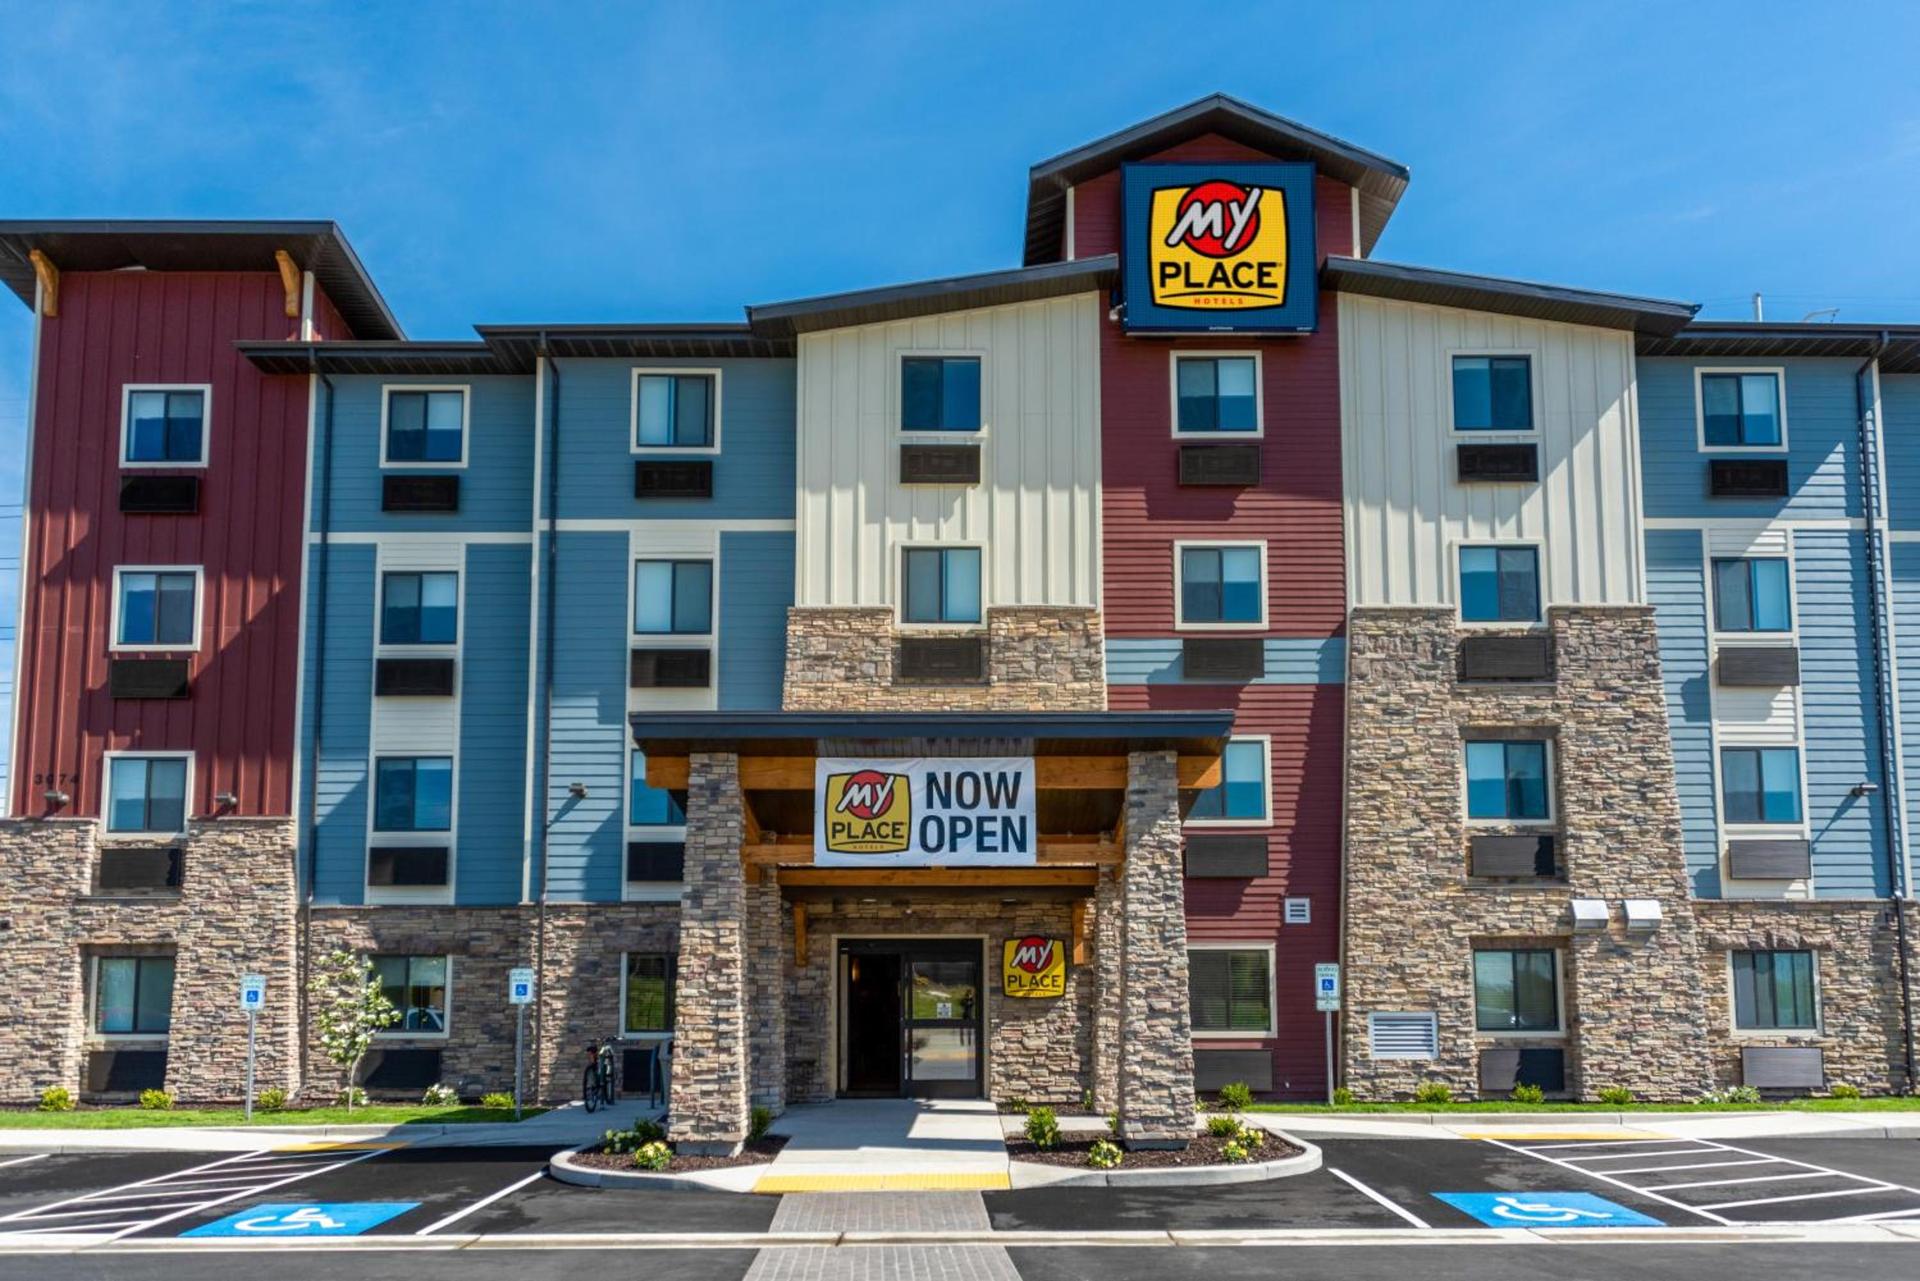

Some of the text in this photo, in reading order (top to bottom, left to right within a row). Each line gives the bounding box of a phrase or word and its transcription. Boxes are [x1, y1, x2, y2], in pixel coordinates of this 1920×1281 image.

[1159, 261, 1278, 288] PLACE
[926, 771, 1022, 810] NOW
[832, 822, 905, 839] PLACE
[919, 815, 1027, 853] OPEN
[1007, 974, 1061, 988] PLACE
